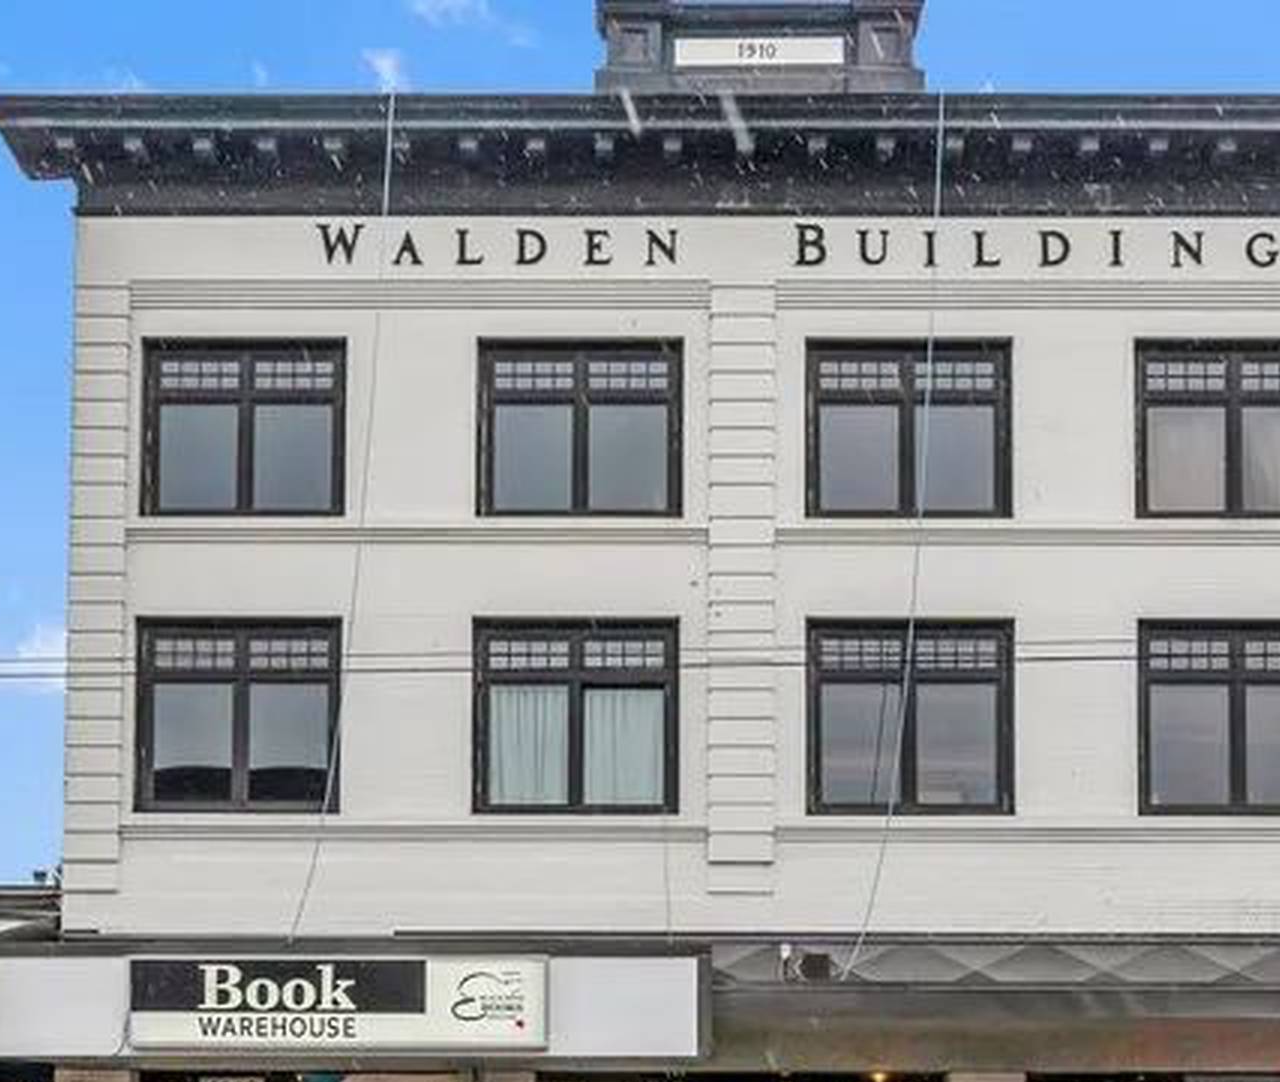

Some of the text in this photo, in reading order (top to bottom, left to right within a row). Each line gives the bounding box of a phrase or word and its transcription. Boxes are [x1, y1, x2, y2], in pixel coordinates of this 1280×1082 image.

[737, 42, 777, 60] 1910
[316, 223, 1280, 268] WALDEN BUILDING
[197, 963, 358, 1011] Book
[197, 1016, 357, 1039] WAREHOUSE
